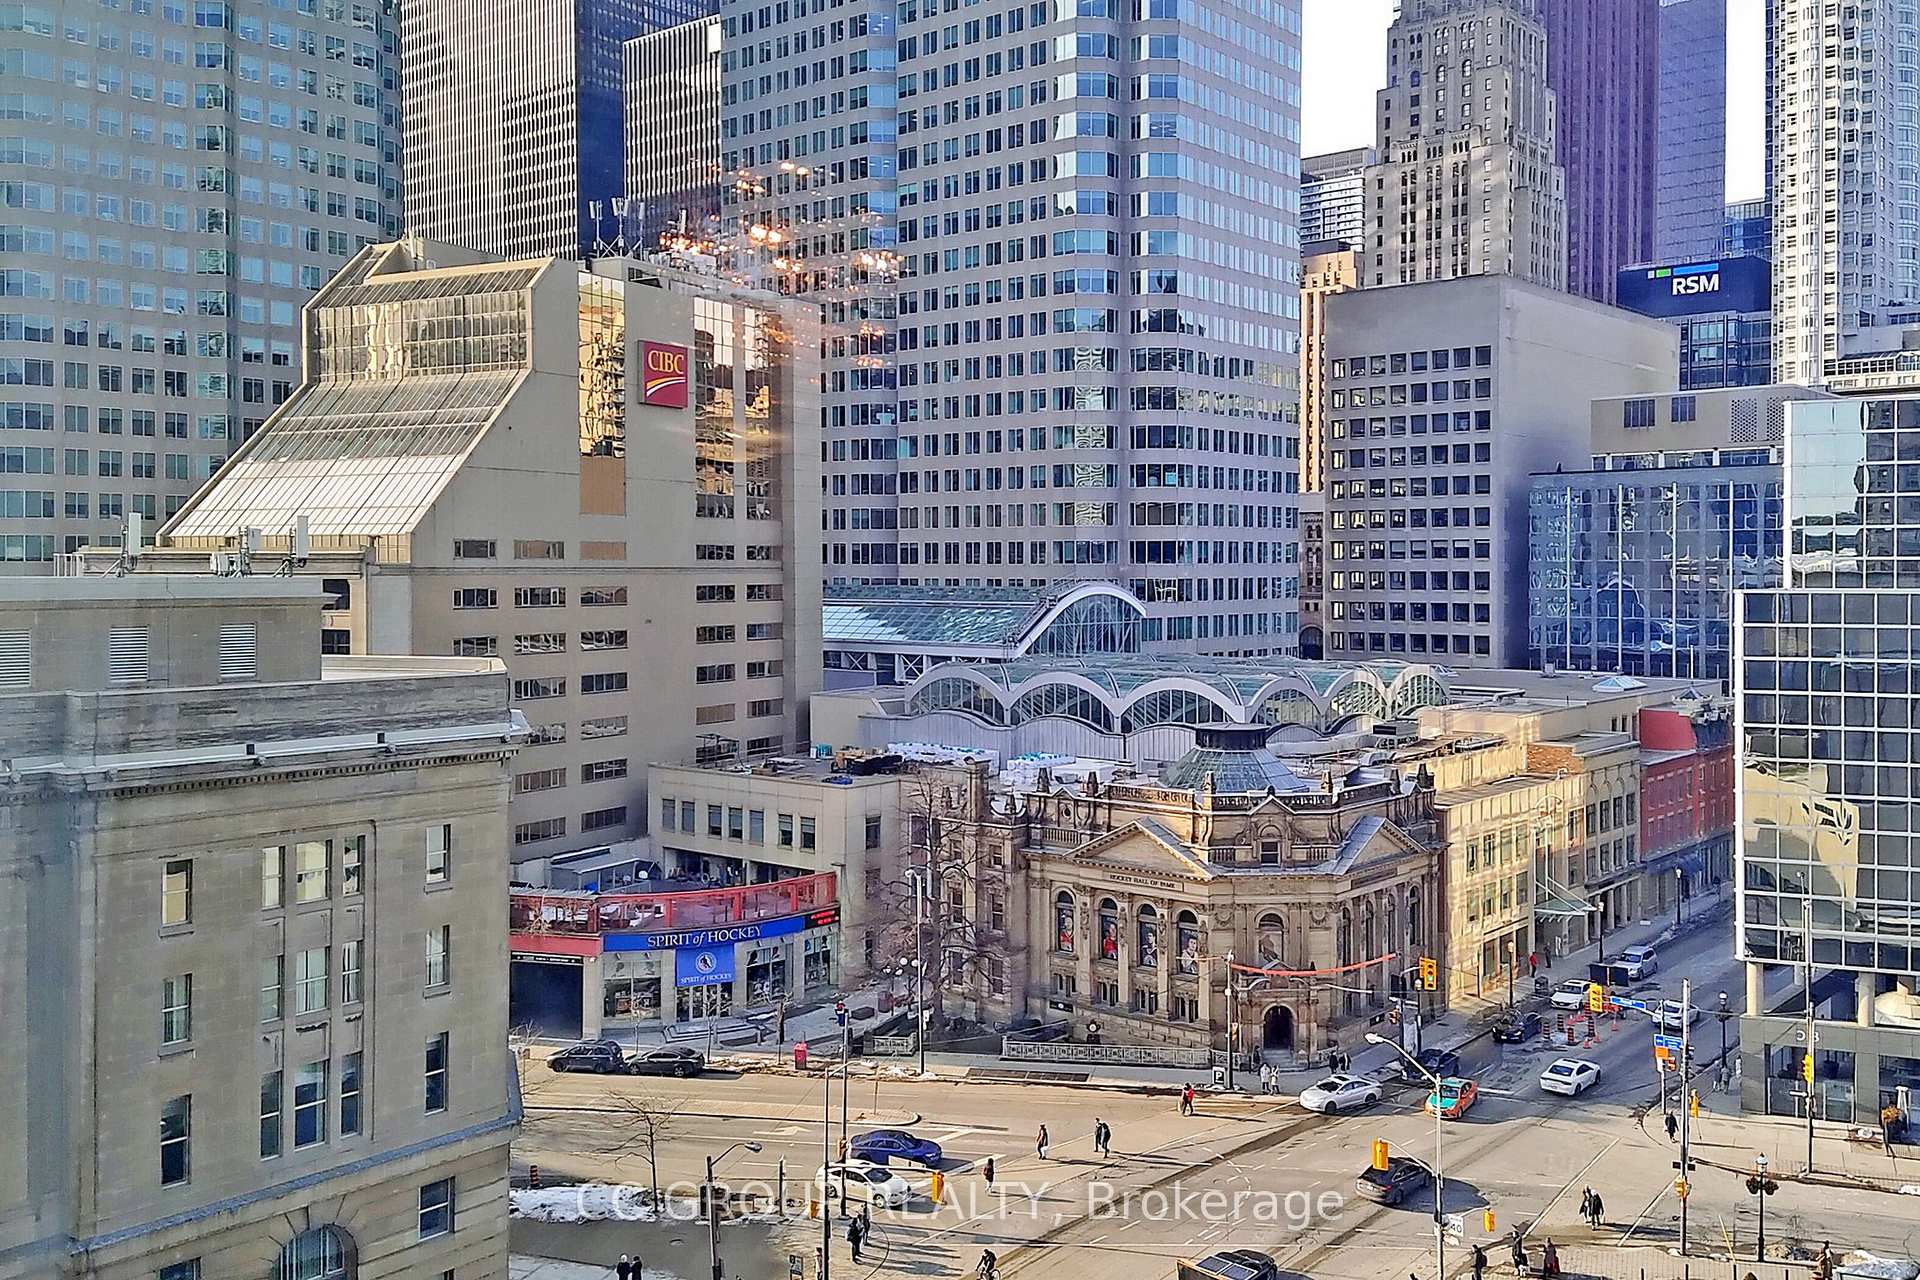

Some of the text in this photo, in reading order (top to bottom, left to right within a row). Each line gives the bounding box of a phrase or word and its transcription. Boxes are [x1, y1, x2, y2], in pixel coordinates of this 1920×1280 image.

[1672, 273, 1719, 296] RSM
[647, 350, 685, 375] CIBC
[647, 926, 761, 947] SPIRIT of HOCKEY
